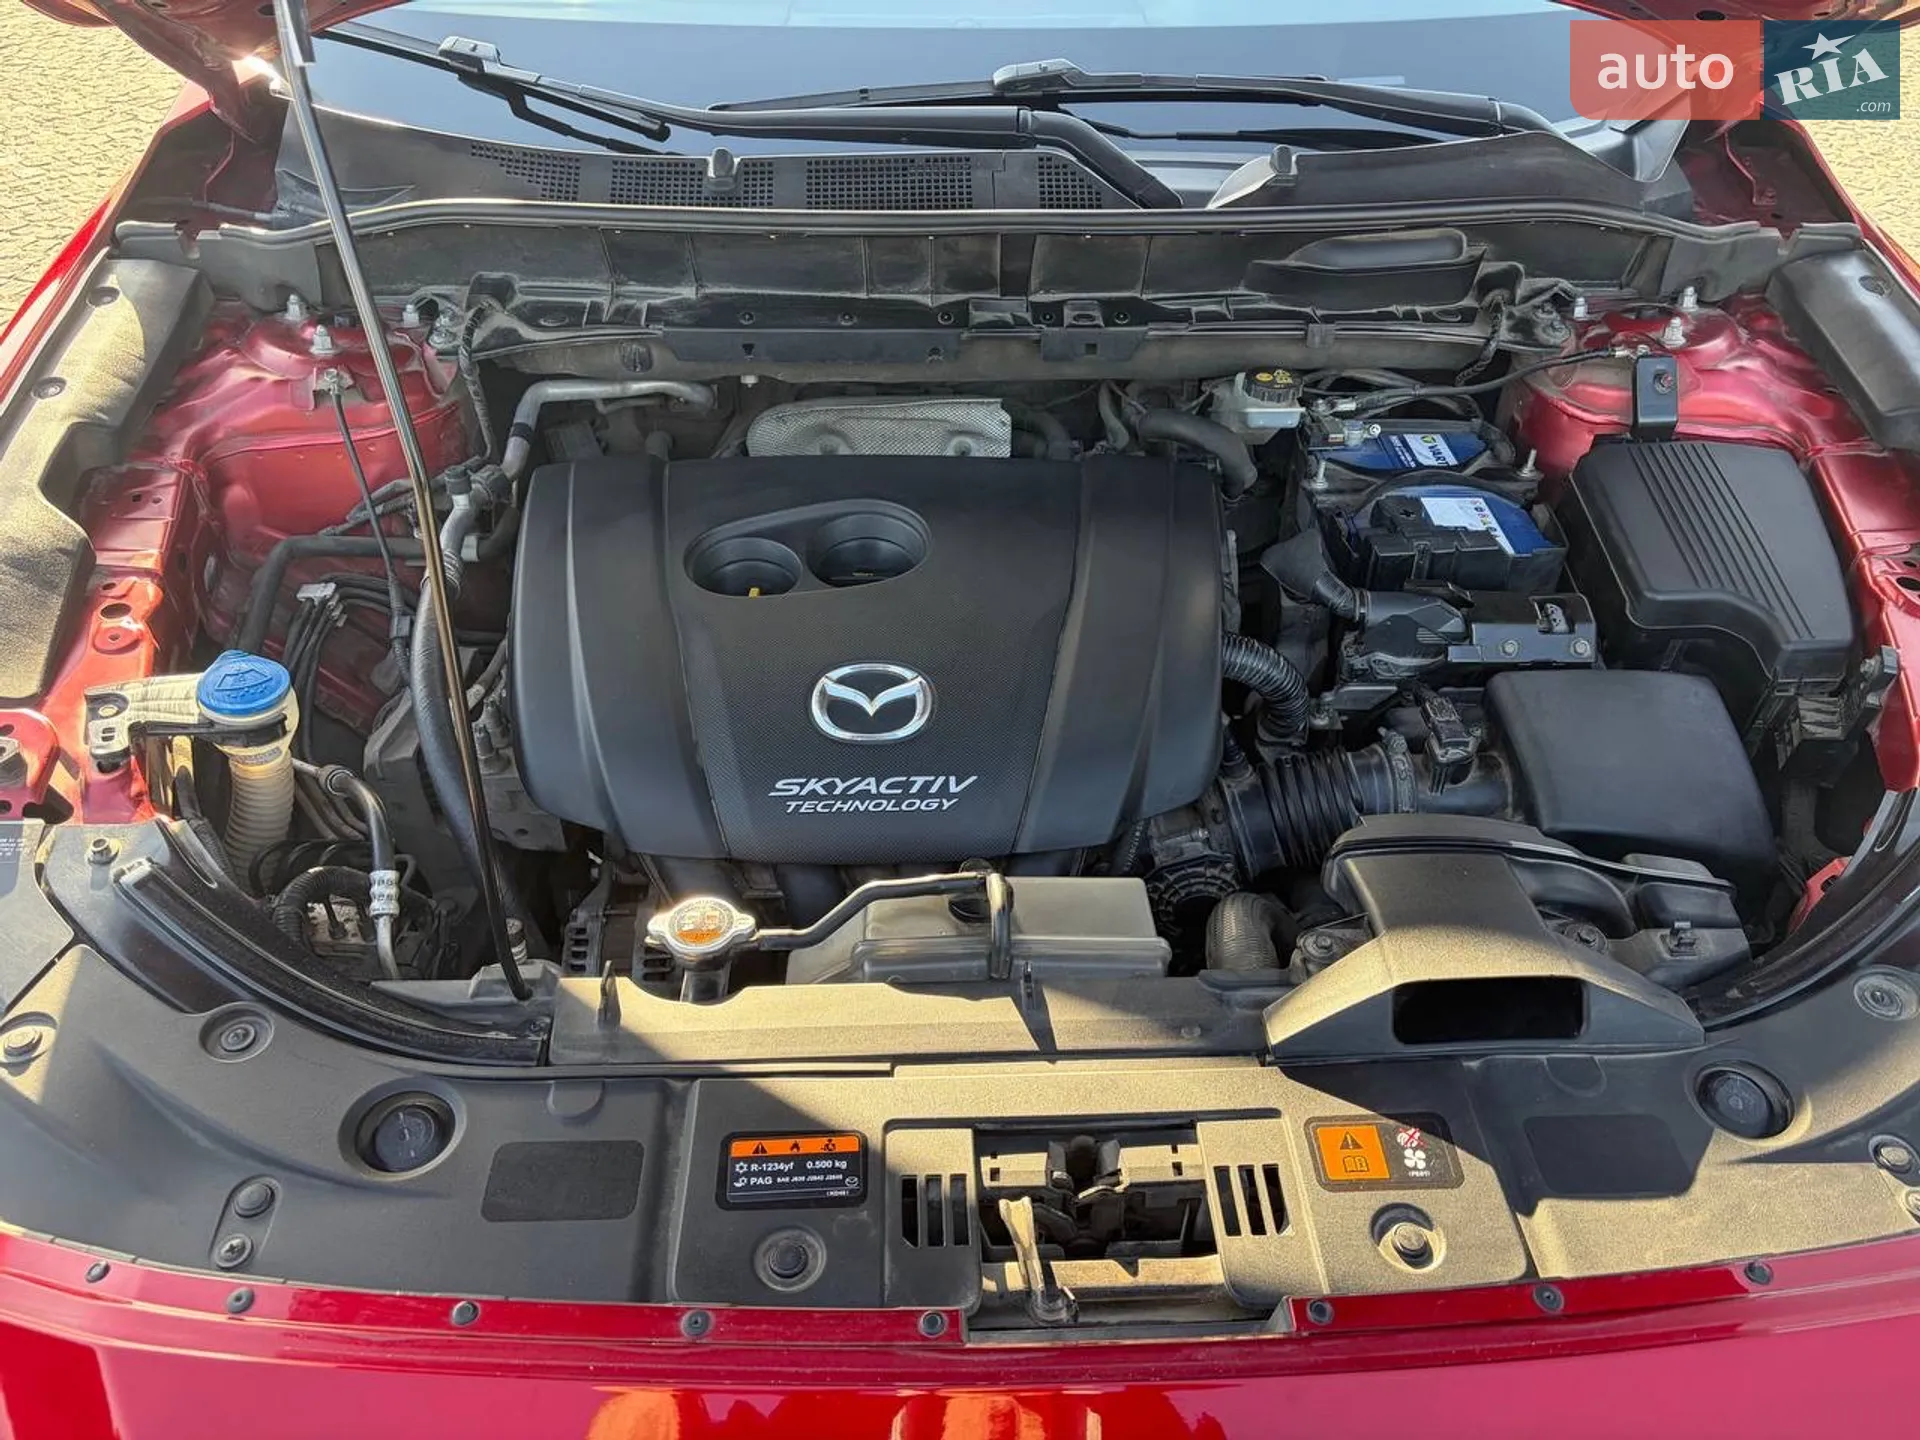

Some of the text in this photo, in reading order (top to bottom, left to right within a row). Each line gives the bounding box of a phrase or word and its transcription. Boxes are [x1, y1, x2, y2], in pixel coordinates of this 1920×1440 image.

[1428, 444, 1449, 465] VART
[768, 775, 978, 796] SKYACTIV
[786, 798, 959, 813] TECHNOLOGY
[750, 1160, 848, 1172] R-1234yf 0.500 kg
[750, 1176, 773, 1185] PAG
